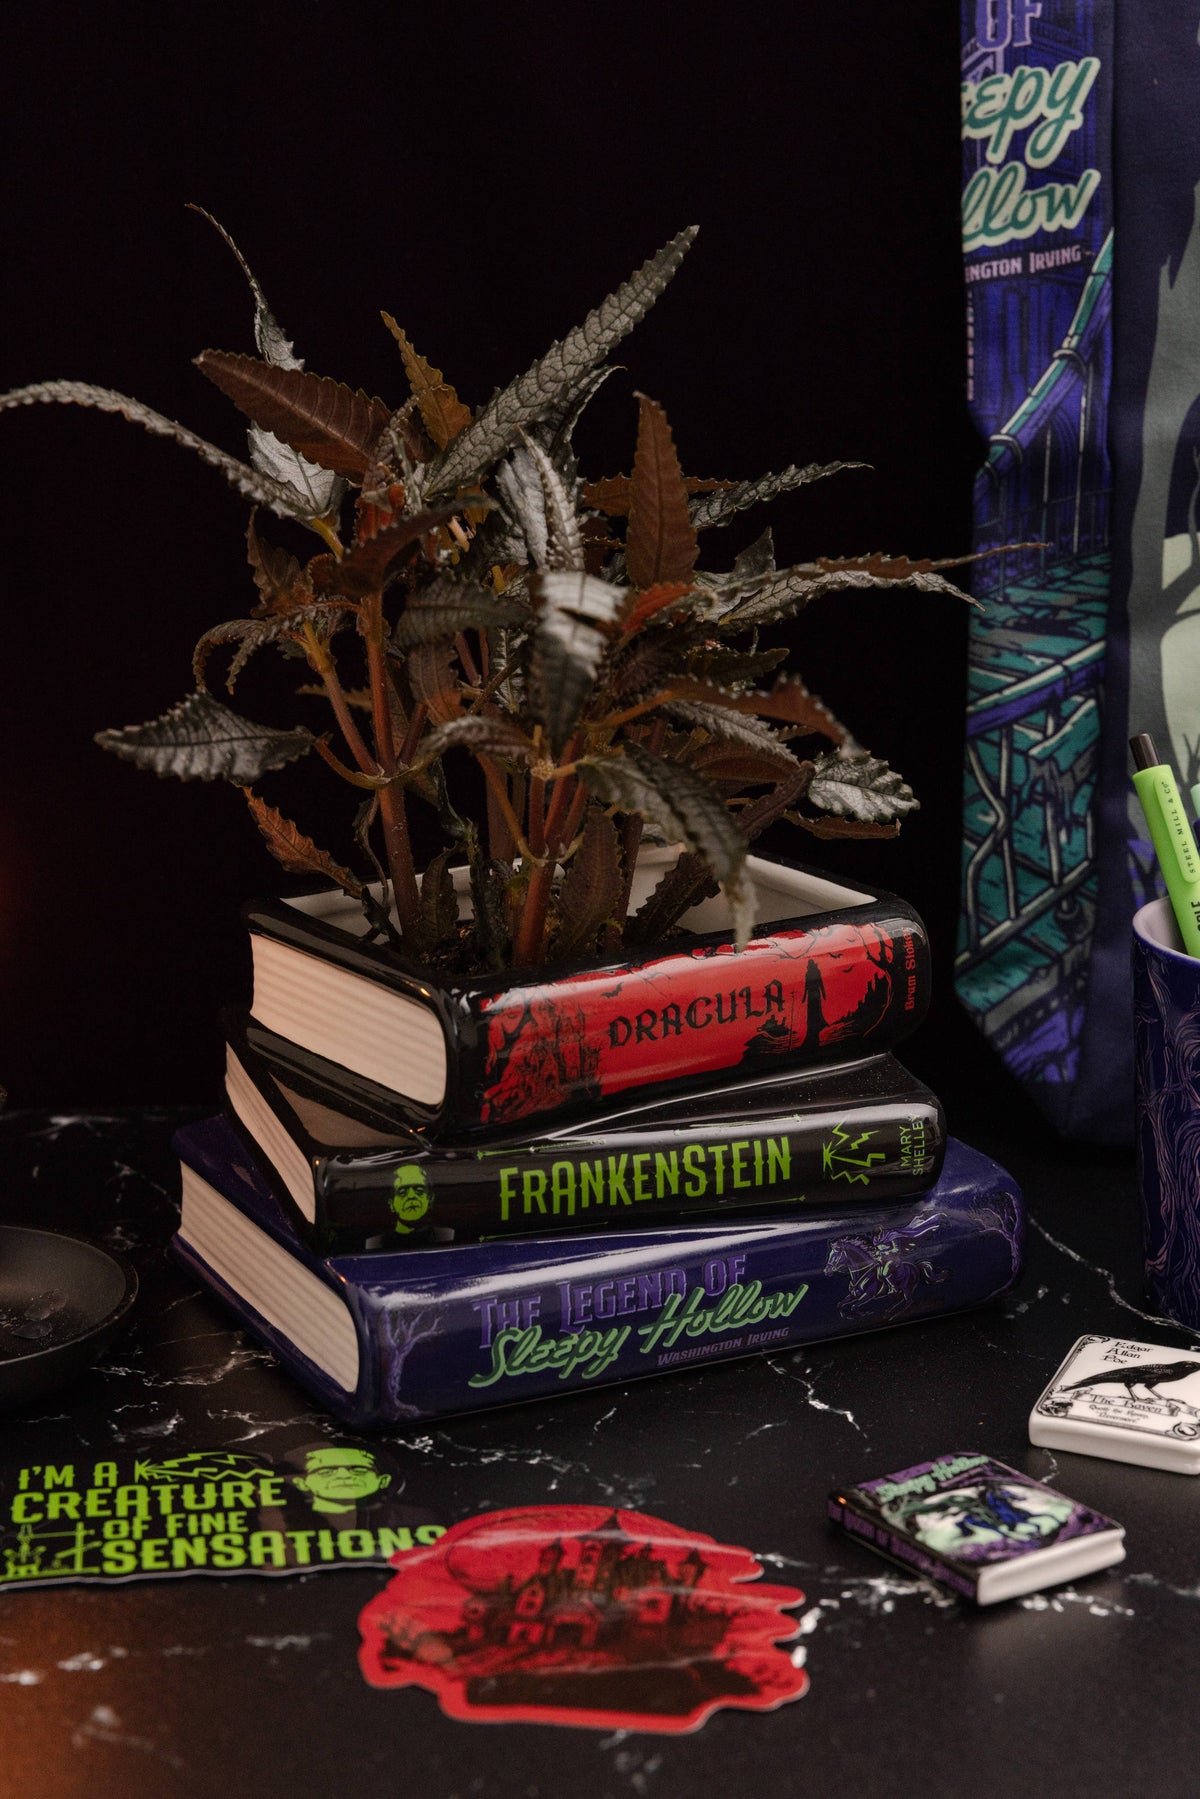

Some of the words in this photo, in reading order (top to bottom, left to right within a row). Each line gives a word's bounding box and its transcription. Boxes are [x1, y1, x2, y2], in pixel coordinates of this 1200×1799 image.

[976, 0, 1042, 50] OF
[1029, 245, 1081, 273] IRVING
[1171, 809, 1184, 835] MILL
[1181, 841, 1196, 874] STEEL
[904, 975, 916, 1011] Bram
[608, 979, 785, 1048] DRACULA
[899, 1126, 912, 1167] MARY
[909, 1113, 925, 1176] SHELLEY
[500, 1136, 792, 1221] FRANKENSTEIN
[473, 1295, 541, 1349] THE
[555, 1268, 687, 1334] LEGEND
[699, 1253, 750, 1296] OF
[468, 1325, 632, 1388] Sleepy
[638, 1280, 808, 1353] Hollow
[656, 1337, 742, 1367] WASHINGTON
[747, 1327, 790, 1346] IRVING
[1106, 1347, 1141, 1359] Allan
[1102, 1354, 1127, 1364] Poe
[18, 1463, 75, 1491] I'M
[93, 1461, 118, 1488] A
[11, 1477, 288, 1524] CREATURE
[102, 1515, 153, 1540] OF
[166, 1511, 249, 1535] FINE
